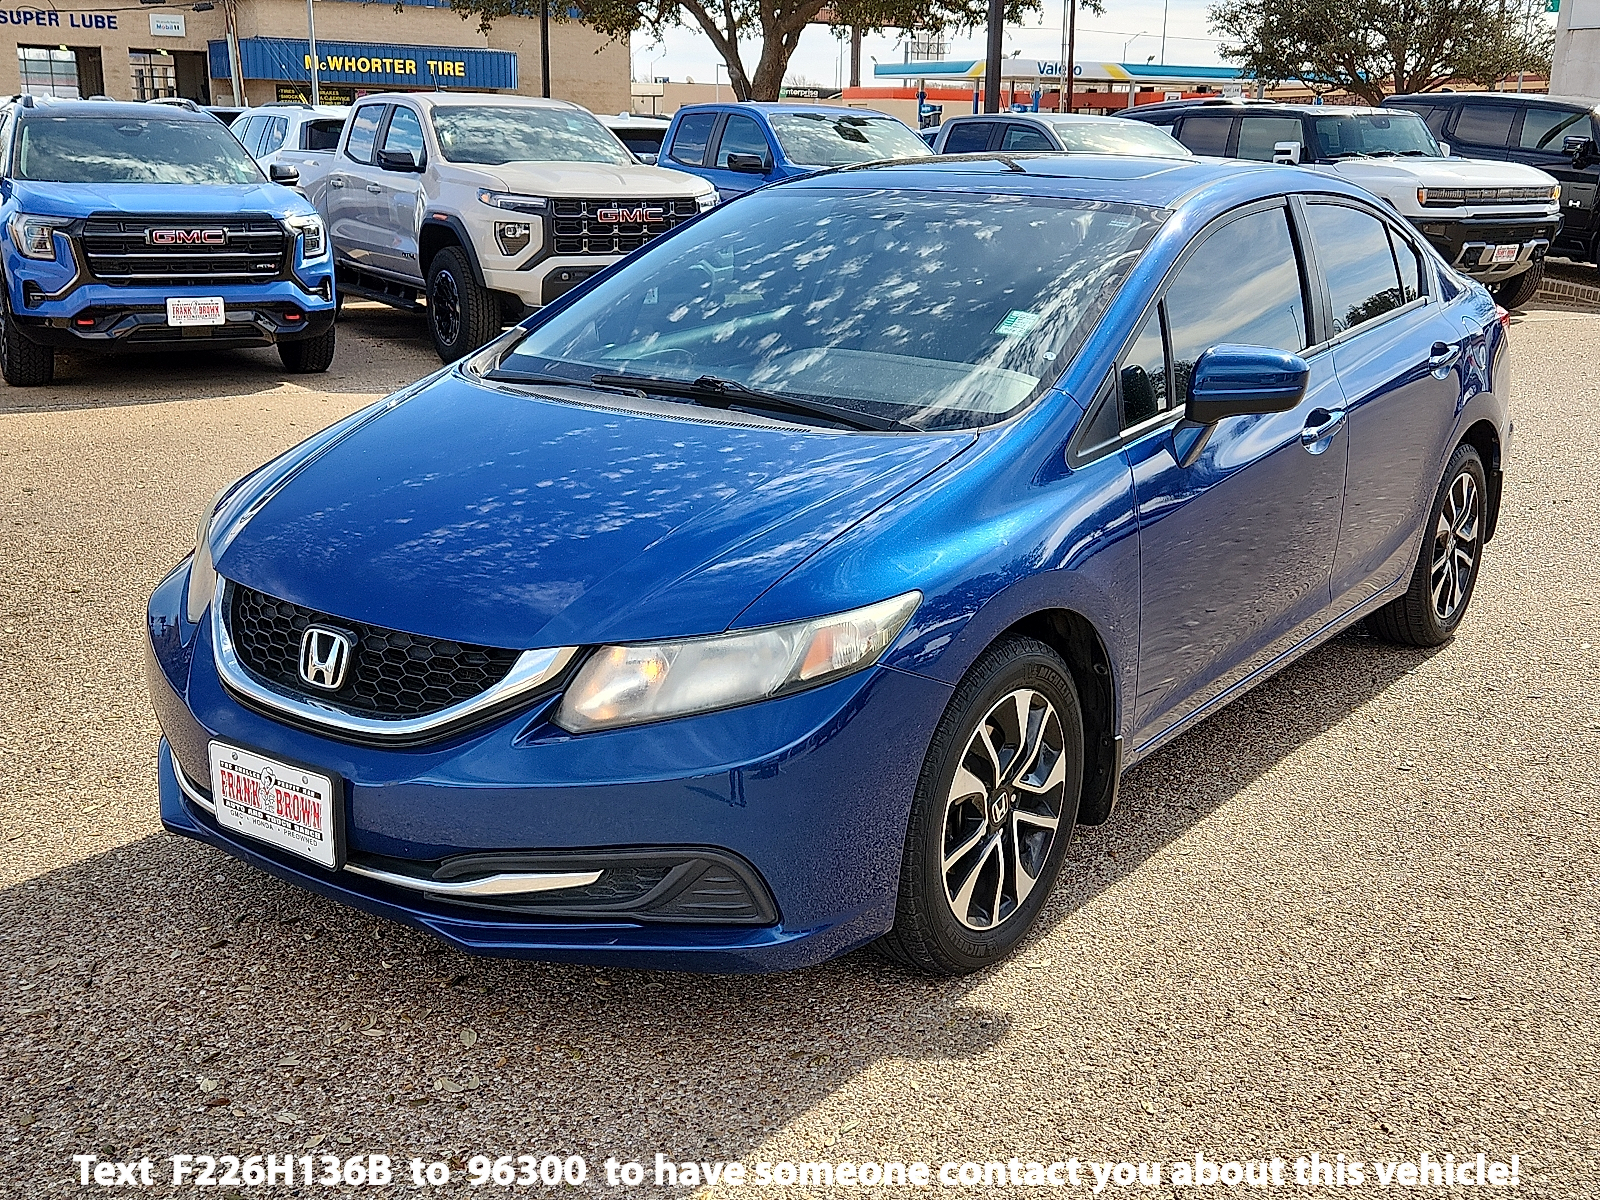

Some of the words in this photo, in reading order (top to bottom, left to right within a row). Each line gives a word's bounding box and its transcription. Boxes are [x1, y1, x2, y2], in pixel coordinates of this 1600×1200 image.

[0, 9, 60, 27] SUPER
[69, 13, 118, 30] LUBE
[304, 54, 417, 75] McWHORTER
[427, 60, 466, 77] TIRE
[1037, 61, 1083, 76] Valeo
[780, 88, 819, 97] enterprise
[597, 208, 664, 223] GMC
[152, 229, 224, 244] GMC
[172, 305, 192, 316] FRANK
[198, 305, 220, 315] BROWN
[1037, 665, 1074, 706] MICHELIN
[220, 770, 261, 808] FRANK
[275, 788, 322, 830] BROWN
[225, 800, 246, 812] AUTO
[247, 808, 264, 819] AND
[294, 823, 320, 840] RANCH
[229, 809, 244, 819] GMC
[252, 818, 274, 831] HONDA
[283, 828, 318, 846] PREOWNED
